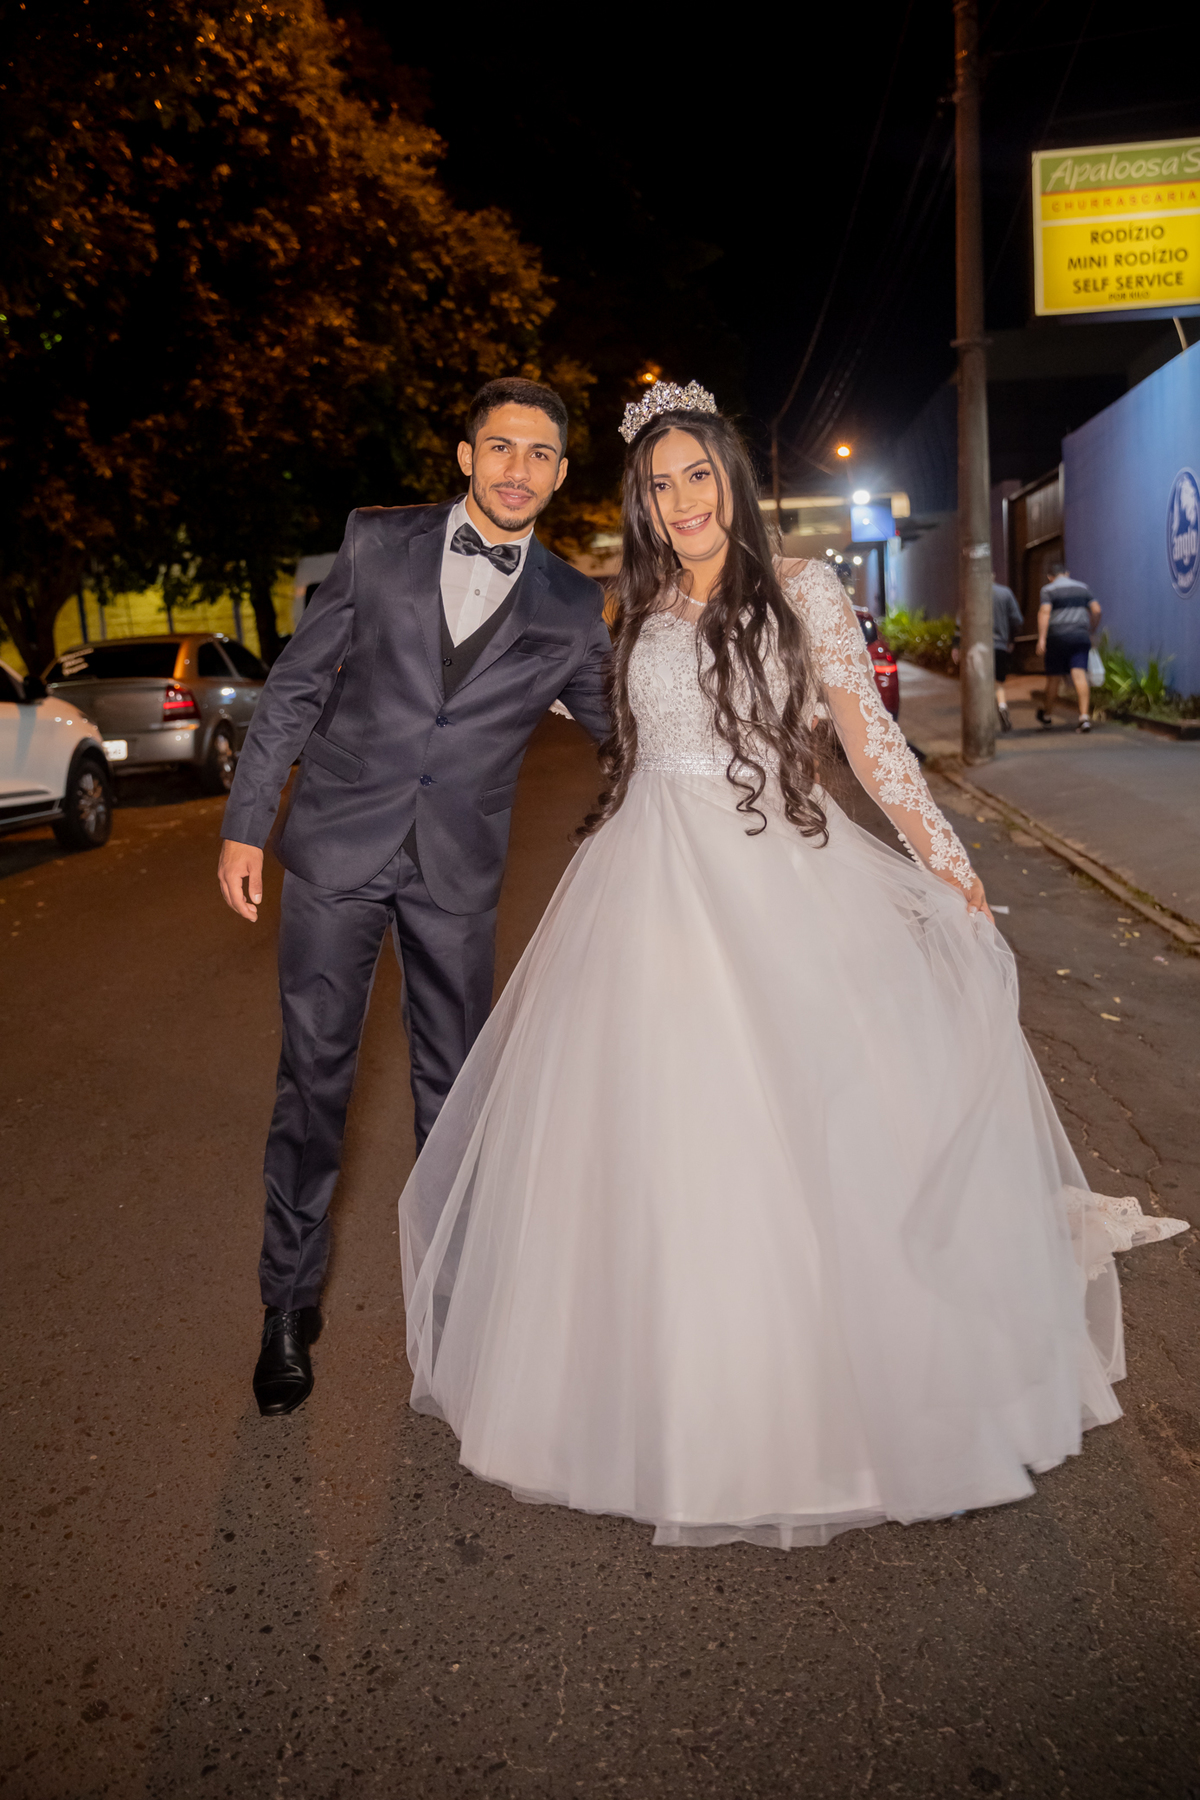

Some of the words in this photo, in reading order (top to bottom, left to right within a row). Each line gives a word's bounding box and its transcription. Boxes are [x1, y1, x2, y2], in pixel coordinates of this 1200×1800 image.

[1052, 190, 1197, 212] CHURRASCARIA
[1090, 224, 1165, 244] RODÍZIO
[1067, 255, 1107, 271] MINI
[1114, 246, 1188, 267] RODÍZIO
[1073, 277, 1110, 294] SELF
[1116, 272, 1183, 290] SERVICE
[1173, 527, 1197, 566] anglo
